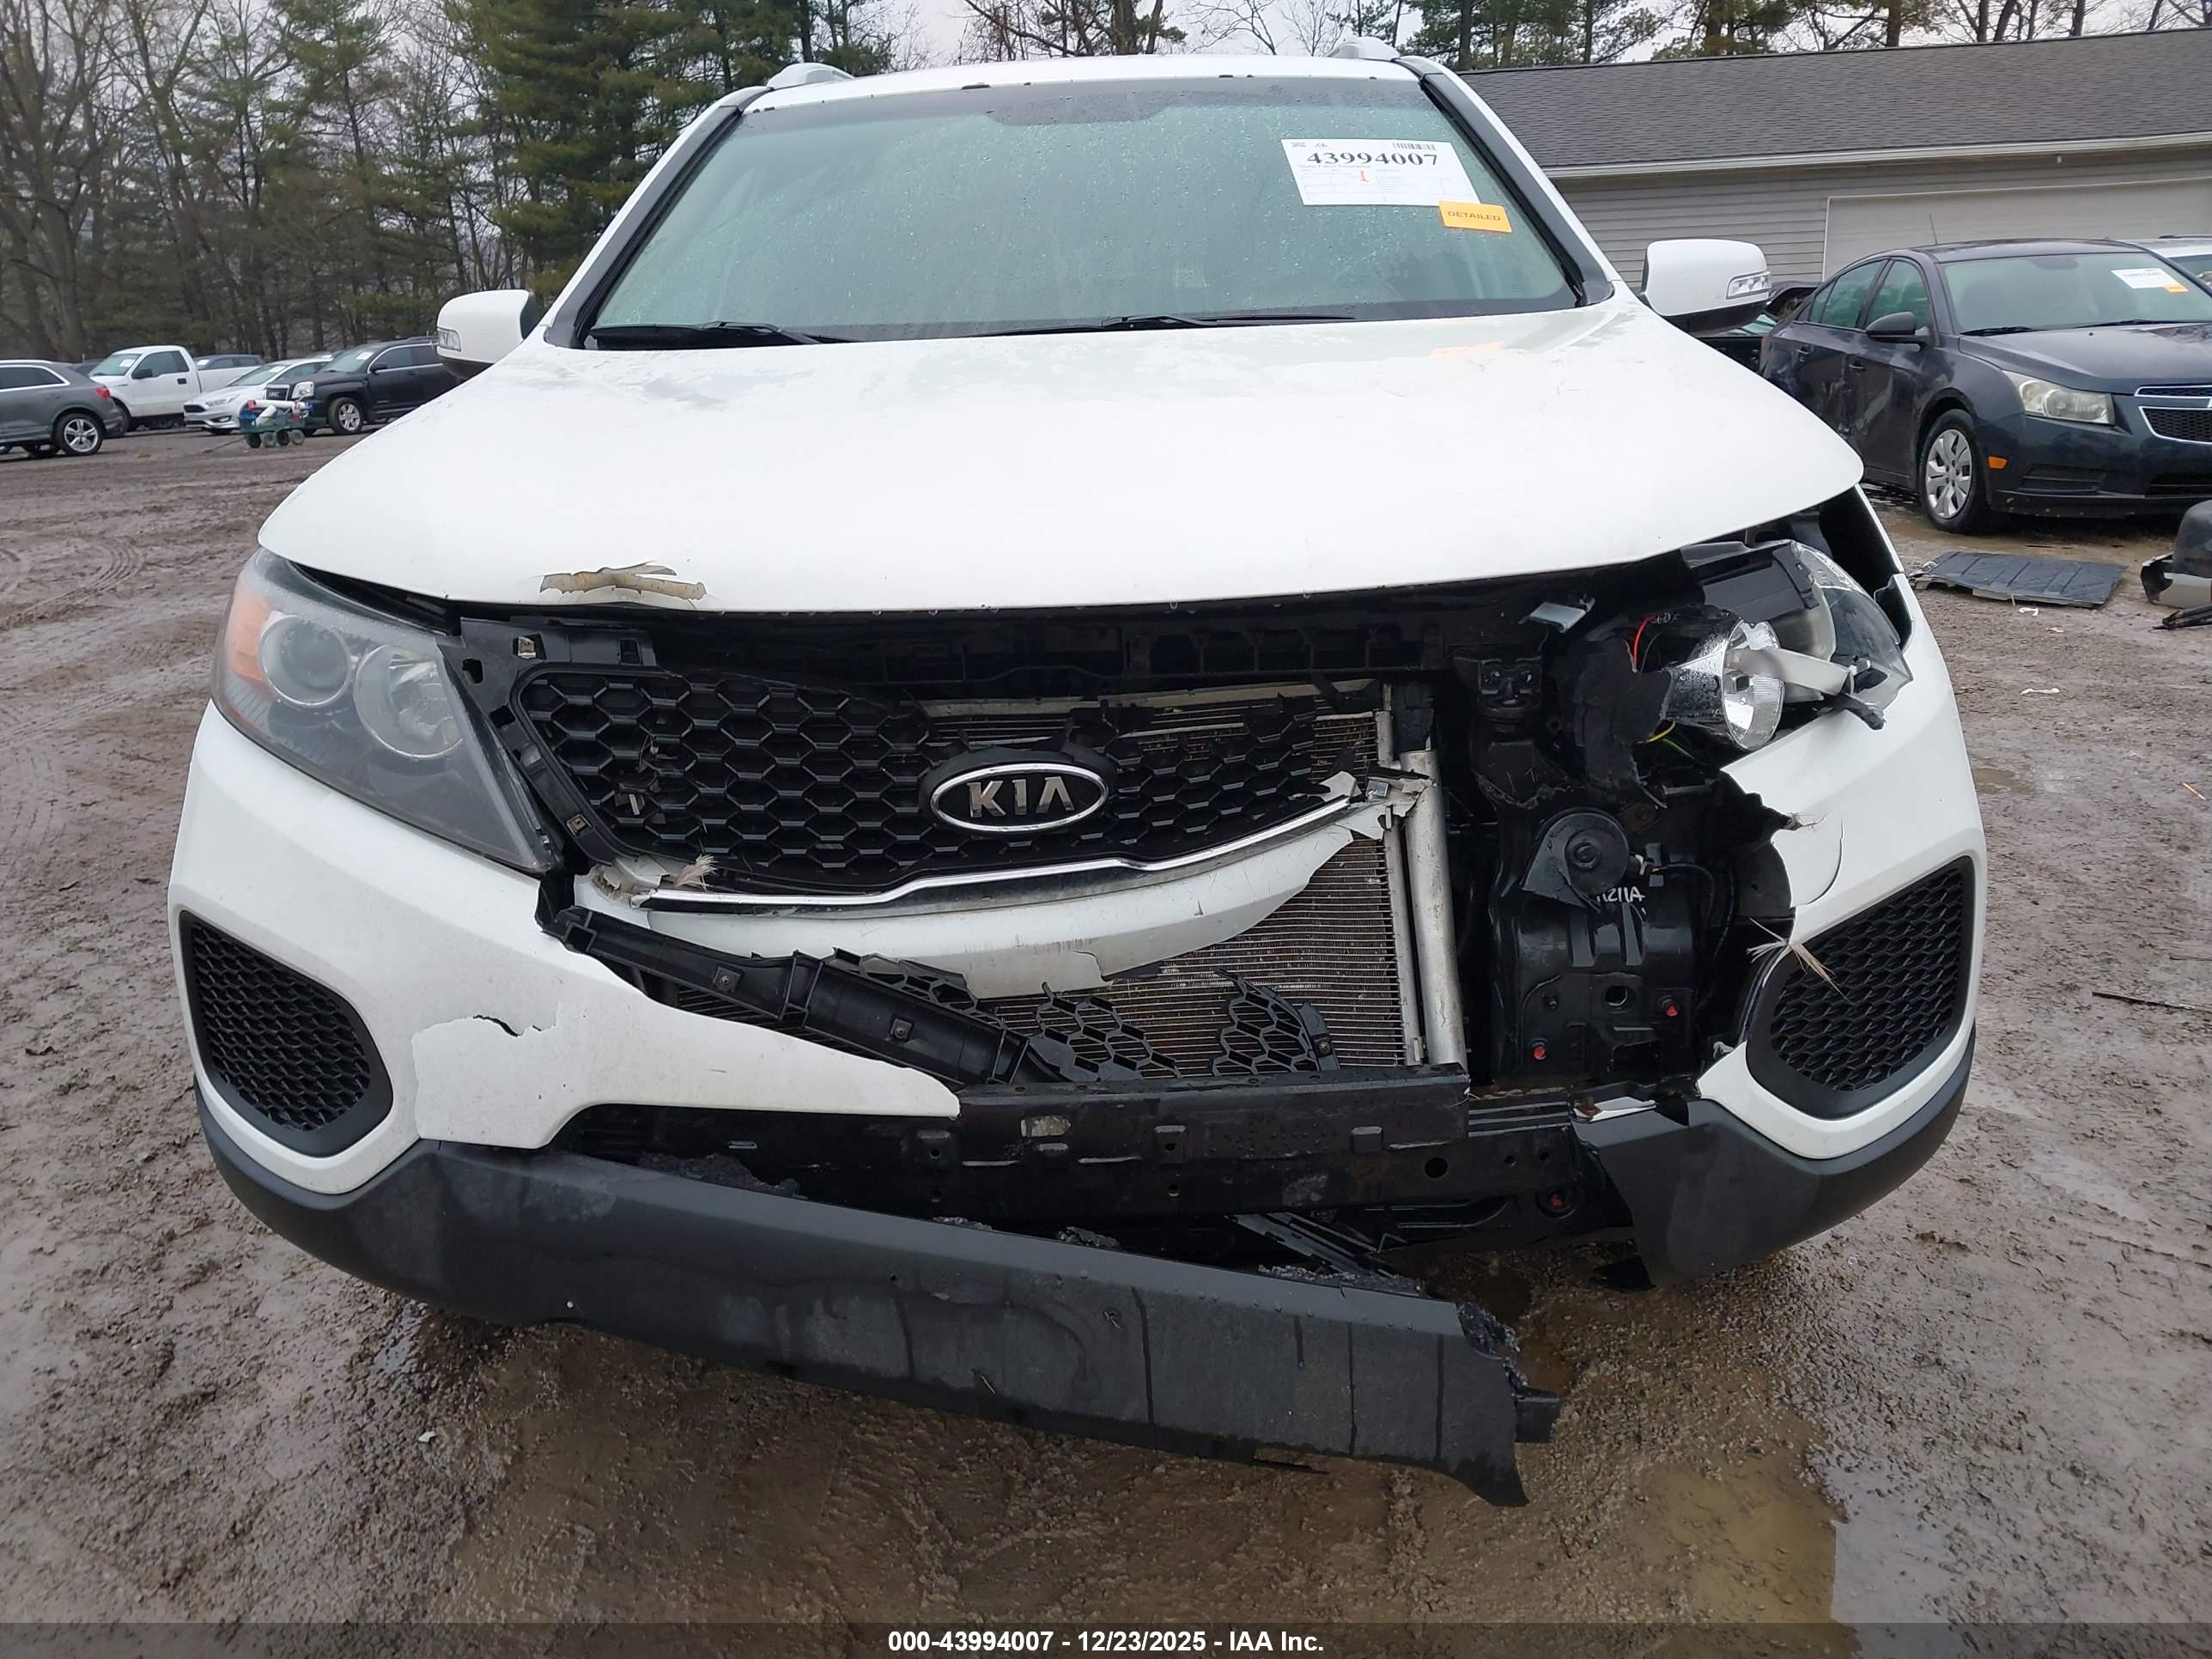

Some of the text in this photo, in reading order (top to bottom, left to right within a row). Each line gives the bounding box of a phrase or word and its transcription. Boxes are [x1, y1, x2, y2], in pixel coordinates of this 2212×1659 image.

[1307, 152, 1437, 166] 43994007
[1448, 210, 1501, 221] DETAILED
[967, 776, 1074, 818] KIA
